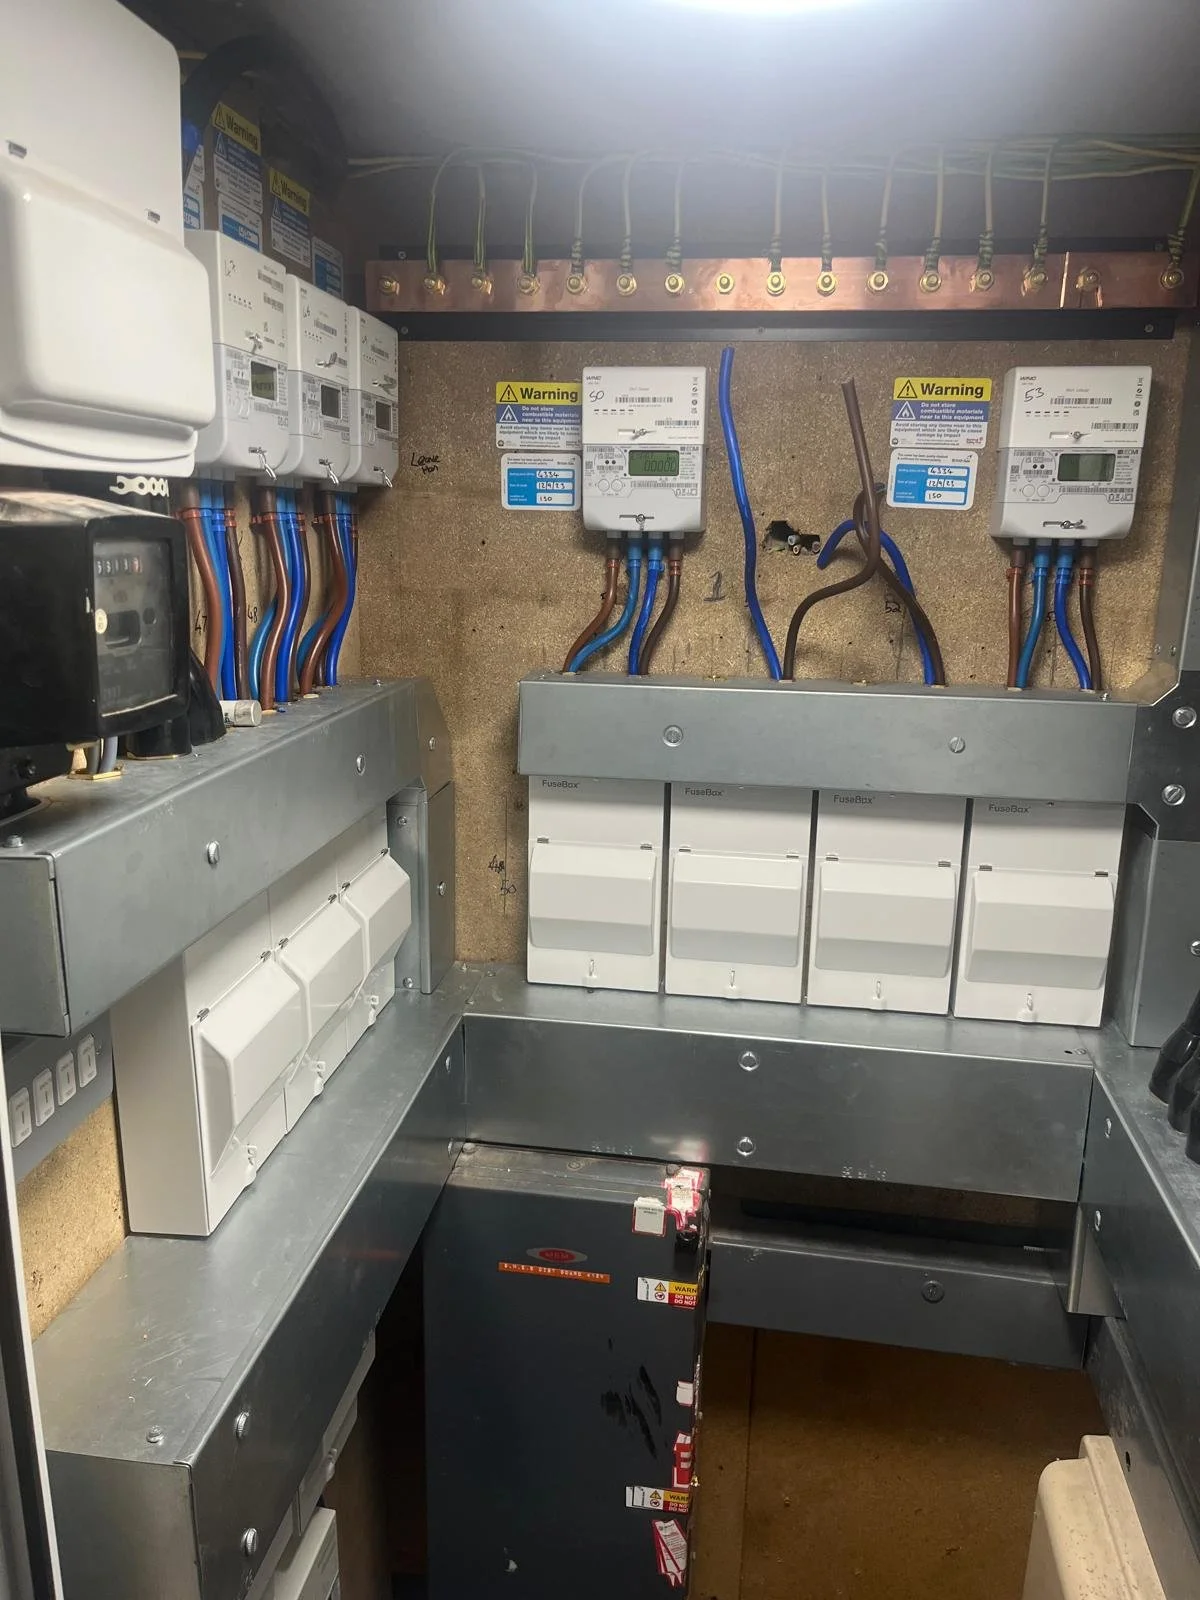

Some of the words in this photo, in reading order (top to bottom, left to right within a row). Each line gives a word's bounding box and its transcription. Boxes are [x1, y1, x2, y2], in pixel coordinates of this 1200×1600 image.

[226, 113, 258, 150] Warning
[280, 179, 306, 212] Warning
[520, 388, 578, 402] Warning
[921, 383, 984, 398] Warning
[1024, 387, 1044, 402] 53
[248, 605, 257, 623] 48
[195, 610, 207, 636] 47
[542, 780, 578, 788] FuseBox
[685, 788, 722, 796] FuseBox
[834, 794, 872, 804] FuseBox
[989, 804, 1029, 813] FuseBox
